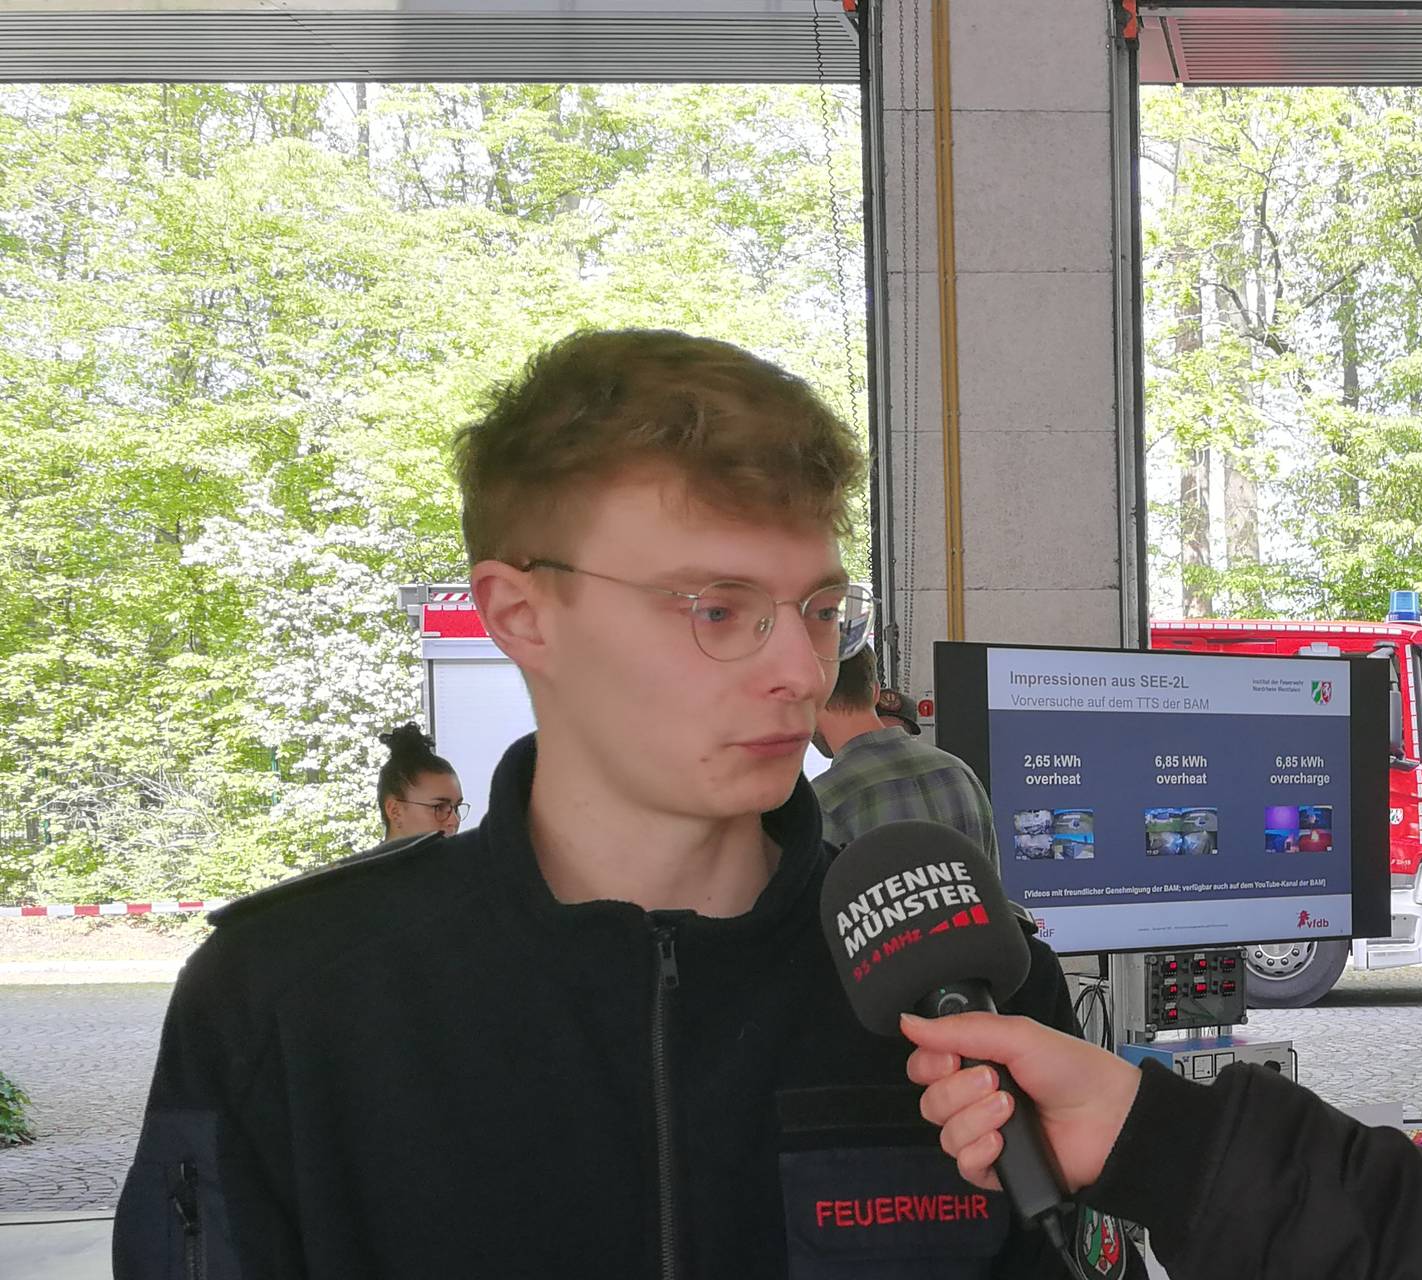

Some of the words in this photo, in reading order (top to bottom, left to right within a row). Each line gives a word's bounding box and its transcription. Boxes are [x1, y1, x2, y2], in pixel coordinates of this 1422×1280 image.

[1010, 671, 1107, 687] Impressionen
[1111, 676, 1136, 687] aus
[1140, 675, 1189, 689] SEE-2L
[1011, 694, 1084, 708] Vorversuche
[1088, 695, 1106, 708] auf
[1108, 696, 1133, 708] dem
[1136, 697, 1160, 709] TTS
[1163, 697, 1180, 710] der
[1184, 698, 1209, 710] BAM
[1024, 755, 1051, 769] 2,65
[1053, 754, 1082, 768] kWh
[1154, 755, 1180, 770] 6,85
[1181, 755, 1208, 768] kWh
[1275, 756, 1299, 770] 6,85
[1300, 755, 1324, 768] kWh
[1025, 773, 1081, 785] overheat
[1156, 773, 1207, 785] overheat
[1270, 772, 1330, 786] overcharge
[1024, 889, 1051, 899] [Videos
[1051, 889, 1063, 897] mit
[1063, 888, 1104, 897] freundlicher
[1105, 886, 1151, 896] Genehmigung
[1152, 885, 1163, 893] der
[1182, 882, 1212, 892] verfügbar
[1213, 882, 1228, 890] auch
[1240, 881, 1254, 889] dem
[1254, 880, 1299, 888] YouTube-Kanal
[836, 861, 972, 936] ANTENNE
[844, 884, 982, 959] MÜNSTER
[1307, 918, 1329, 928] vfdb
[883, 928, 922, 956] MHz
[815, 1193, 988, 1228] FEUERWEHR
